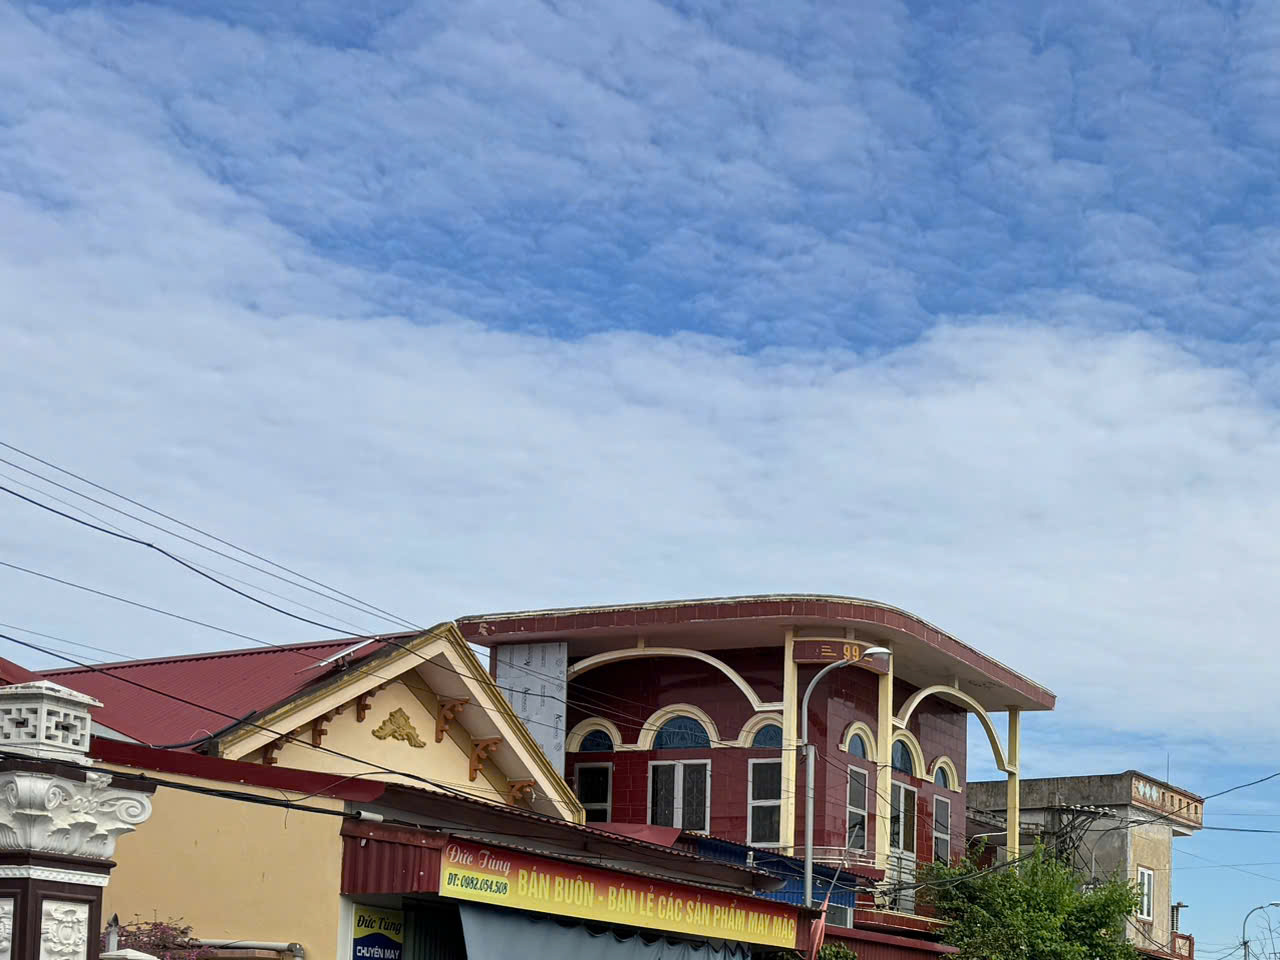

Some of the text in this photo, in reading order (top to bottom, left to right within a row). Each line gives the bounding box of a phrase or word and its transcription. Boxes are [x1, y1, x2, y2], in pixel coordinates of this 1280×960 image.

[446, 844, 511, 876] Đức Tùng
[518, 866, 550, 900] BÁN
[555, 875, 595, 908] BUÔN
[608, 882, 636, 915] BÁN
[640, 885, 654, 917] LẺ
[658, 892, 682, 922] CÁC
[686, 895, 711, 927] SẢN
[713, 899, 746, 931] PHẨM
[749, 911, 771, 935] MAY
[772, 913, 795, 943] MẶC
[357, 914, 402, 935] Đức Tùng
[356, 945, 400, 960] CHUYÊN MAY
